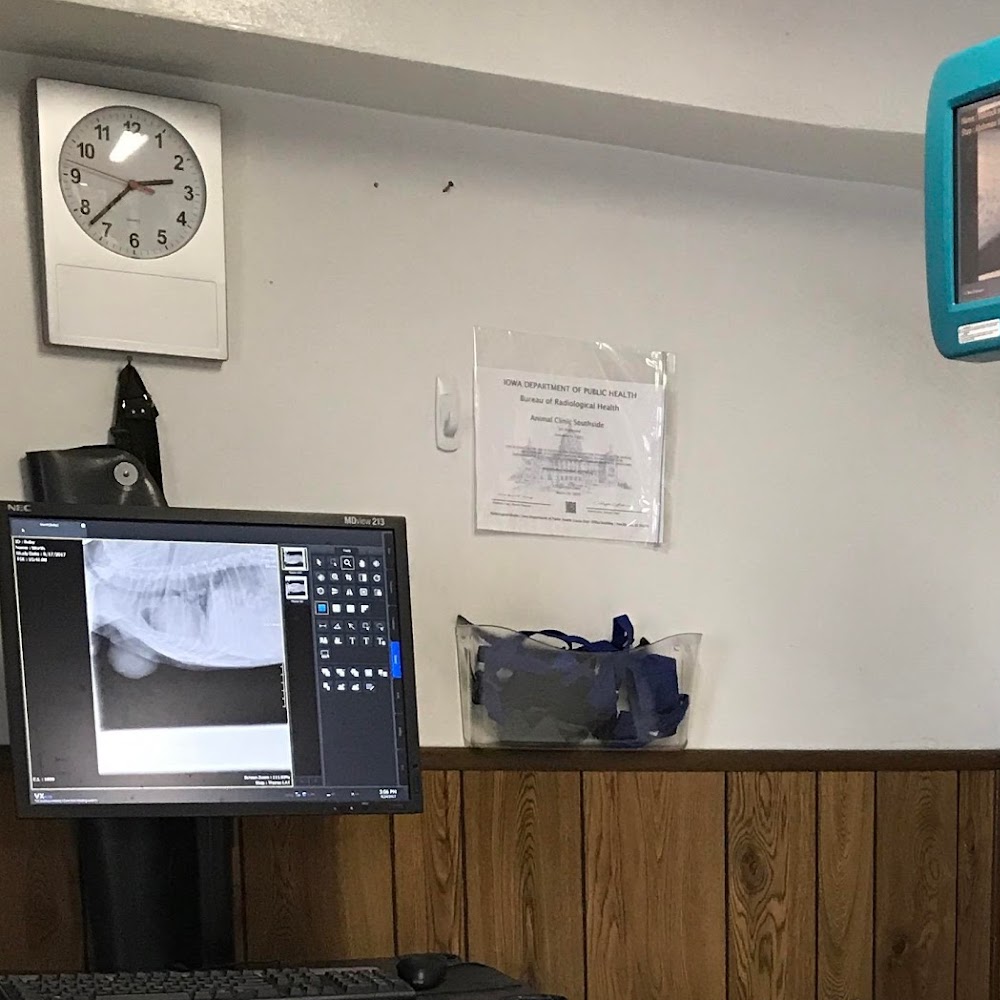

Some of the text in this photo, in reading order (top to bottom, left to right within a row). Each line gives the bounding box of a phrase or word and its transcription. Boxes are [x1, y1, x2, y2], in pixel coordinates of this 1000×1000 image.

[94, 124, 110, 141] 11
[154, 133, 163, 148] 1
[77, 142, 95, 159] 10
[174, 155, 184, 171] 2
[70, 168, 81, 184] 9
[183, 185, 194, 201] 3
[80, 199, 91, 215] 8
[176, 211, 187, 226] 4
[102, 222, 112, 237] 7
[157, 229, 167, 245] 5
[129, 233, 140, 248] 6
[503, 379, 638, 399] IOWA DEPARTMENT OF PUBLIC HEALTH
[520, 395, 544, 404] Bureau
[554, 398, 596, 410] Radiological
[597, 403, 620, 411] Health
[530, 414, 605, 428] Animal Clinic Southside
[7, 504, 32, 512] NEC
[372, 517, 386, 526] 213
